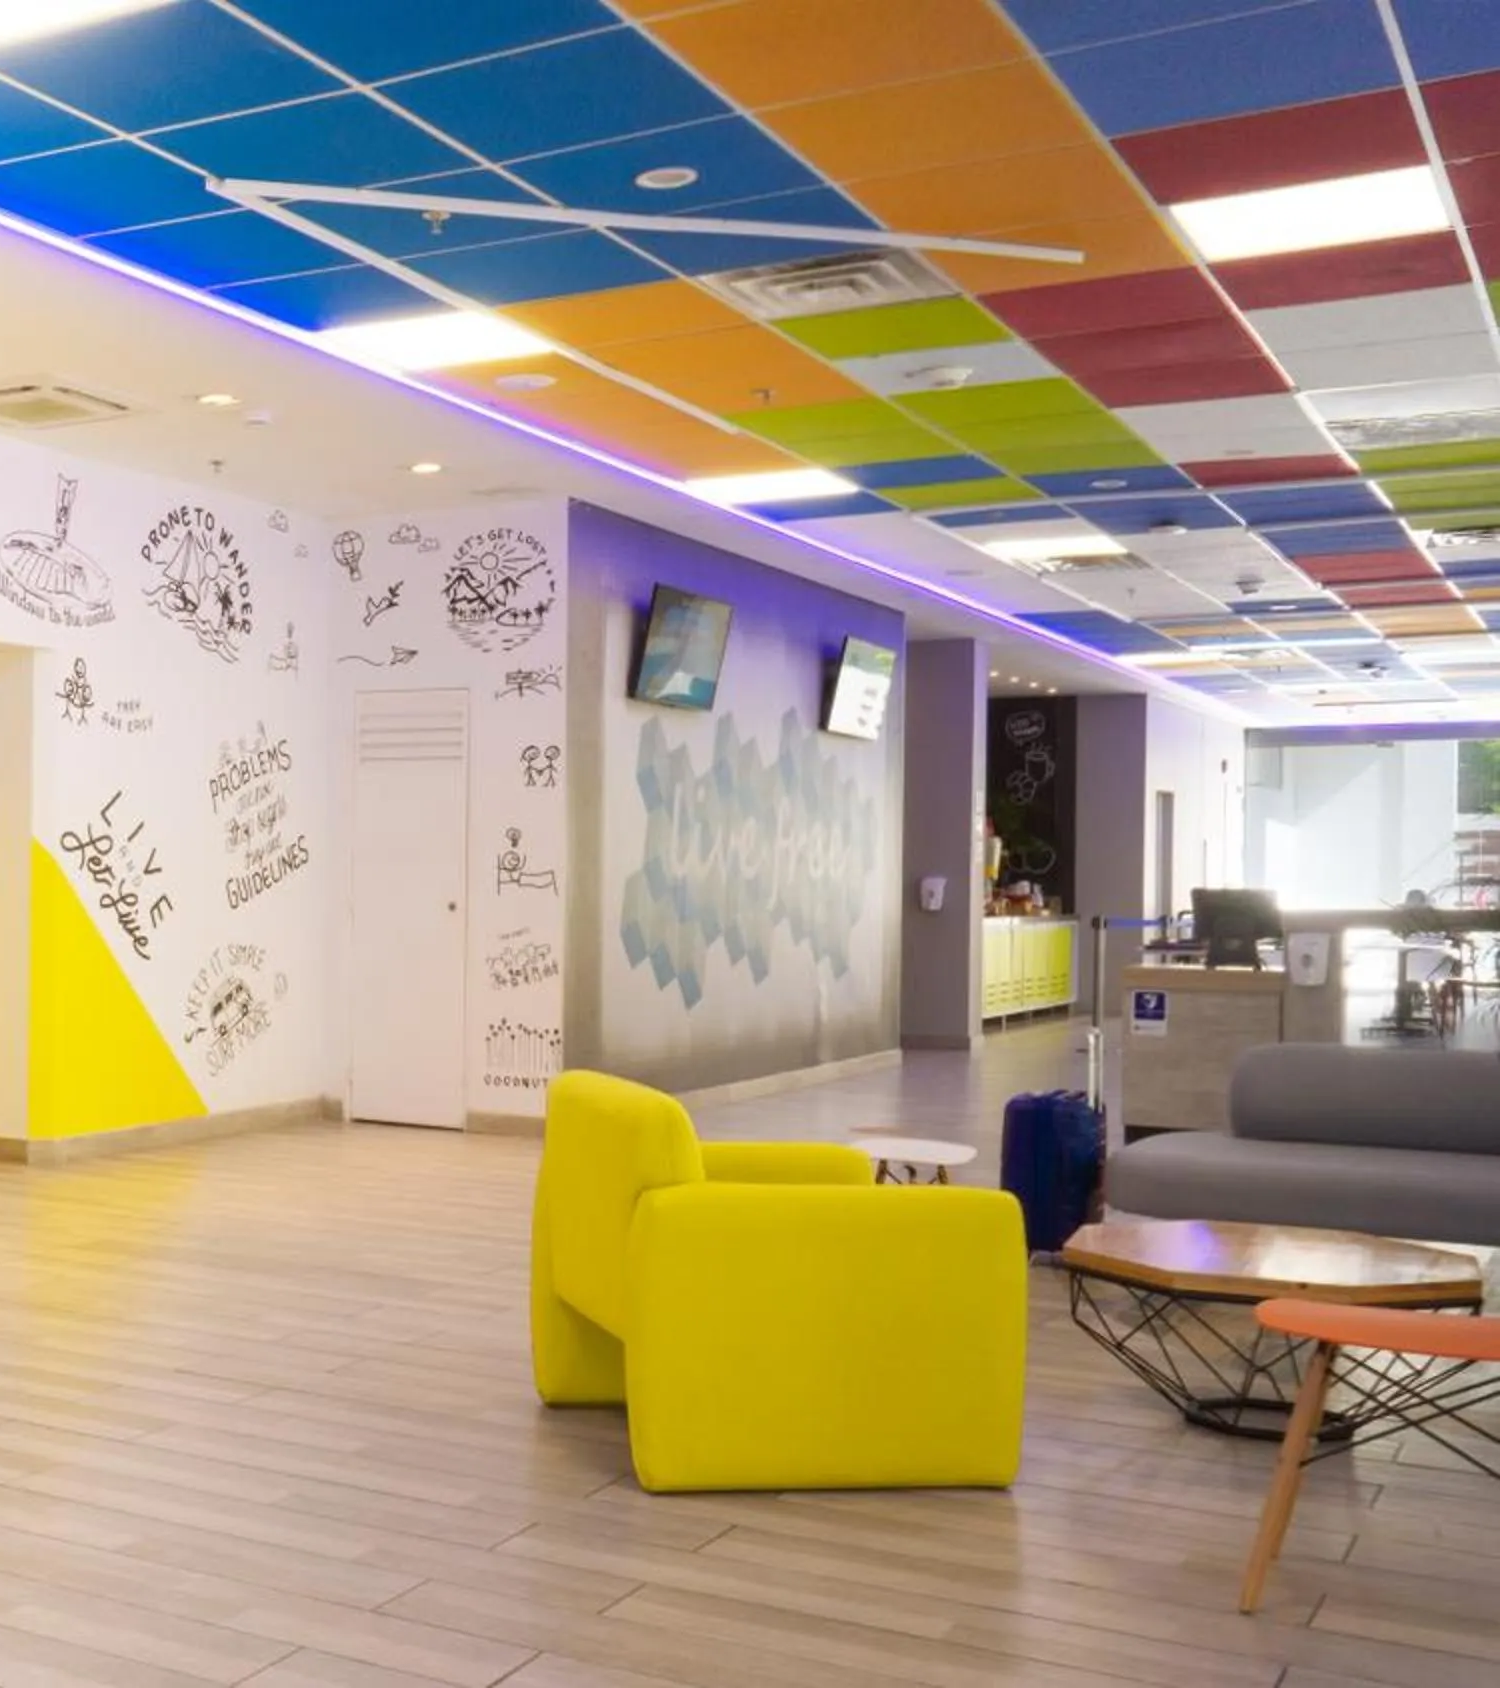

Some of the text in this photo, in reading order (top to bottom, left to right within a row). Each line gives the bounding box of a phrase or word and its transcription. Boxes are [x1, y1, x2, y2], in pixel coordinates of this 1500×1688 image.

[141, 505, 253, 635] PRONE TO WANDER
[452, 527, 548, 561] LET'S GET LOST
[208, 738, 293, 815] PROBLEMS
[100, 789, 175, 930] LIVE
[225, 833, 310, 910] GUIDELINES
